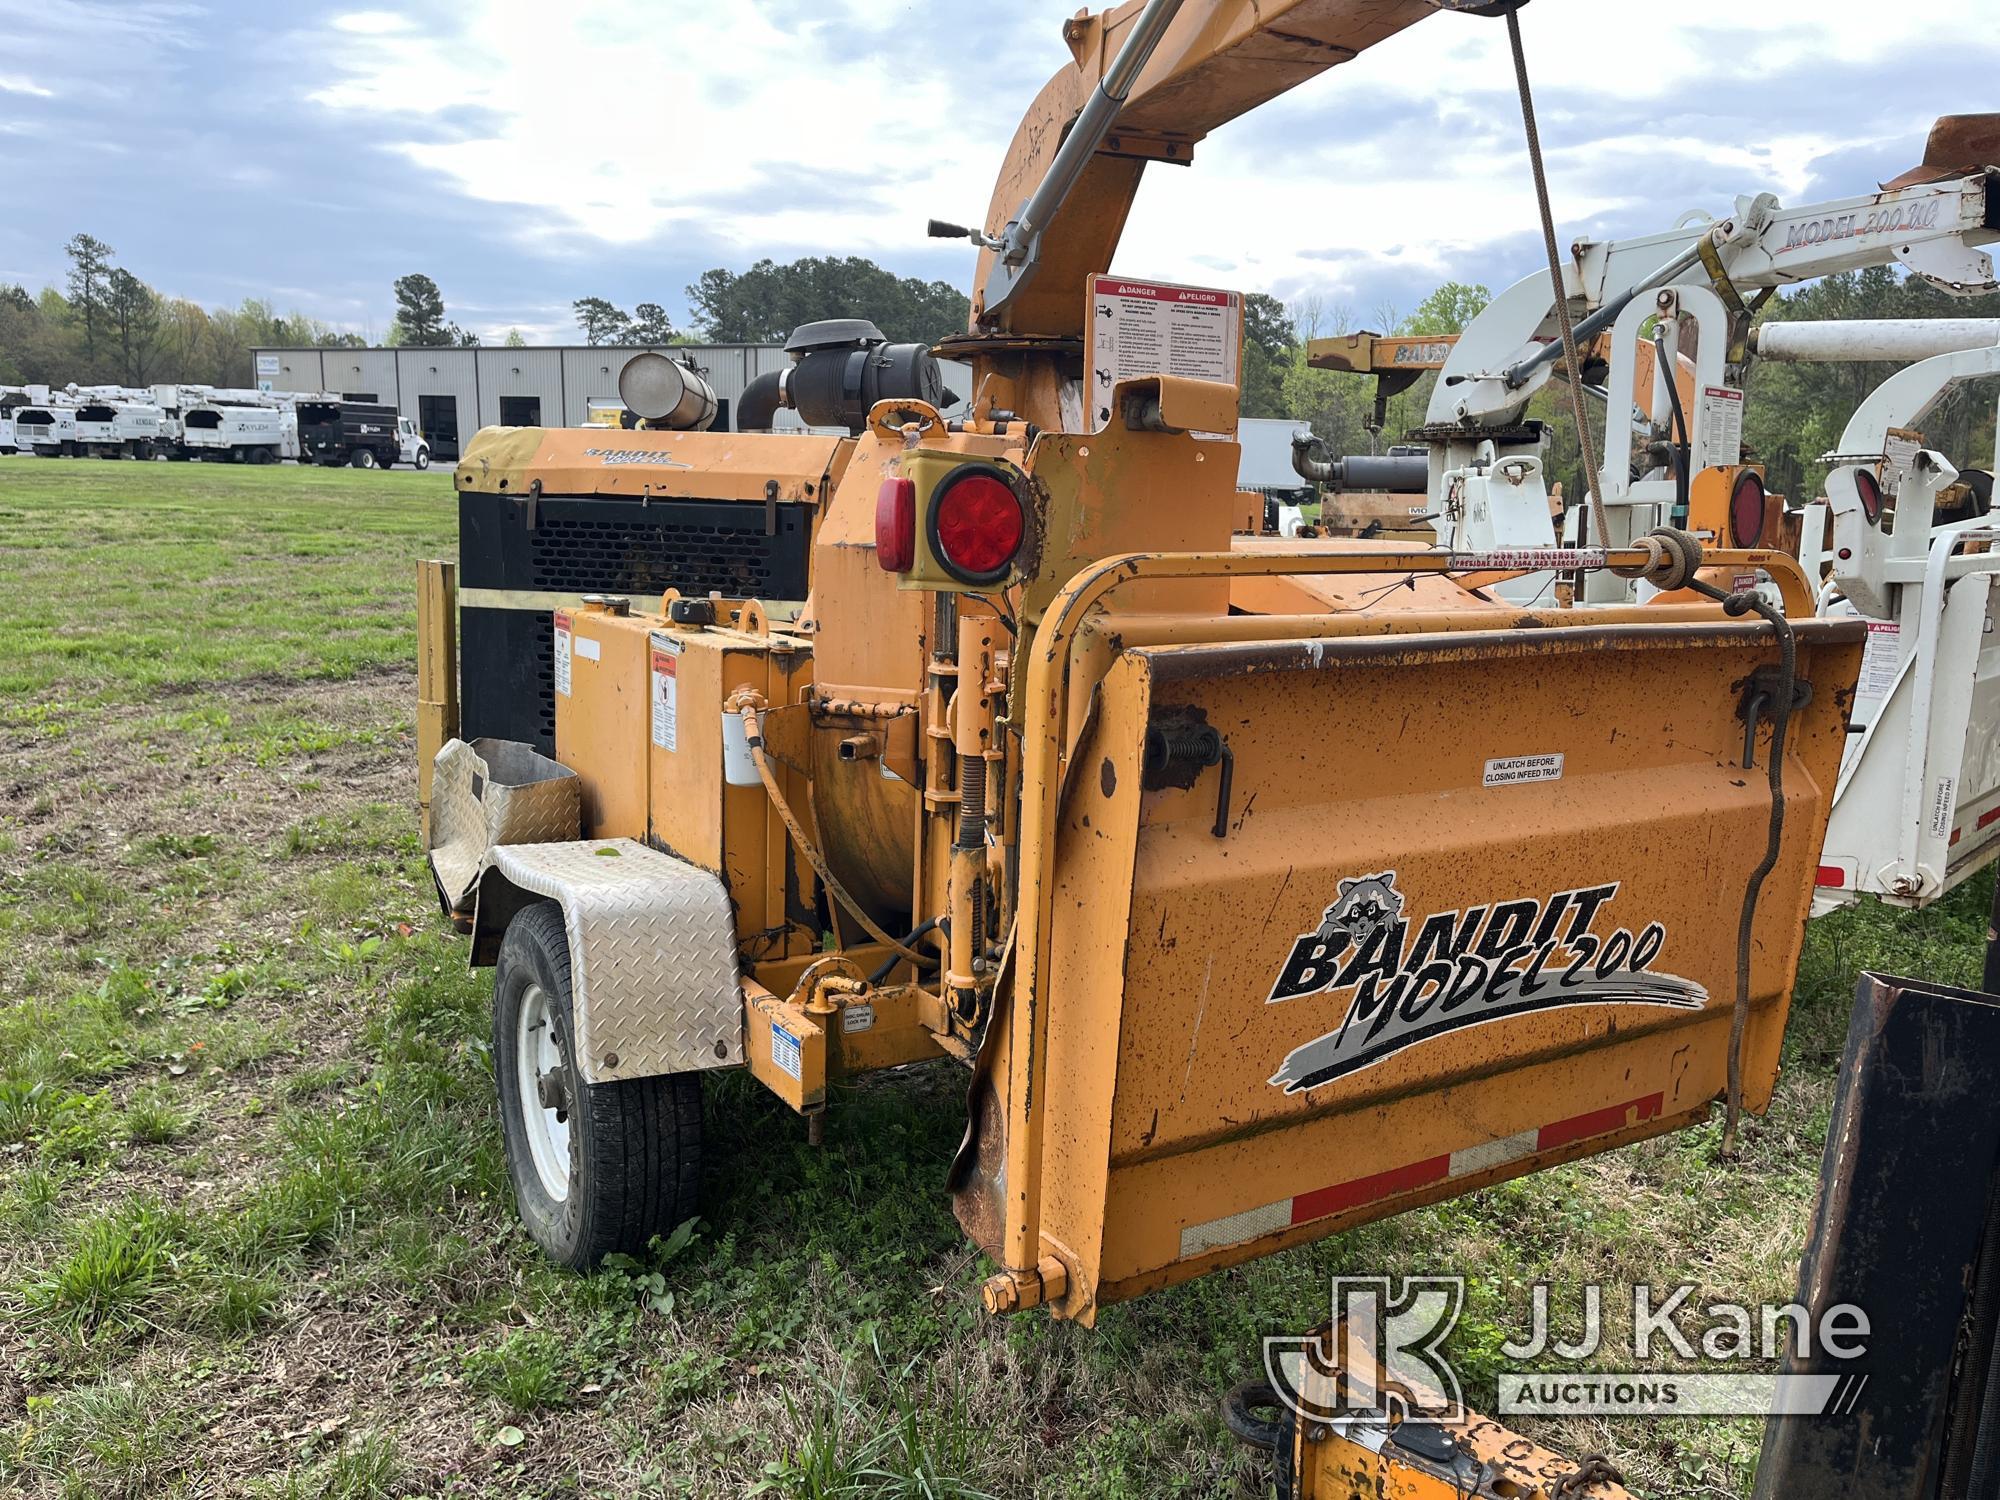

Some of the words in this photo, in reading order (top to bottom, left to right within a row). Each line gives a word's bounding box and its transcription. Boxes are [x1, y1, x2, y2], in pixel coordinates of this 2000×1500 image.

[1786, 214, 1857, 249] MODEL
[1862, 206, 1905, 234] 200
[1126, 286, 1156, 296] DANGER
[1186, 293, 1216, 302] PELIGRO
[584, 447, 672, 458] BANDIT
[1486, 551, 1513, 561] PUSH
[1518, 551, 1530, 560] TO
[1534, 551, 1576, 560] REVERSE
[1493, 760, 1525, 770] UNLATCH
[1527, 757, 1555, 767] BEFORE
[1485, 770, 1516, 782] CLOSING
[1517, 768, 1541, 779] INFEED
[1542, 768, 1560, 776] TRAY
[1936, 783, 1945, 805] BEFORE
[1932, 805, 1941, 832] UNLATCH
[1938, 812, 1947, 837] CLOSING
[1943, 791, 1951, 812] INFEED
[1267, 882, 1619, 1003] BANDIT
[1335, 940, 1558, 1050] MODEL
[1560, 921, 1666, 987] 200
